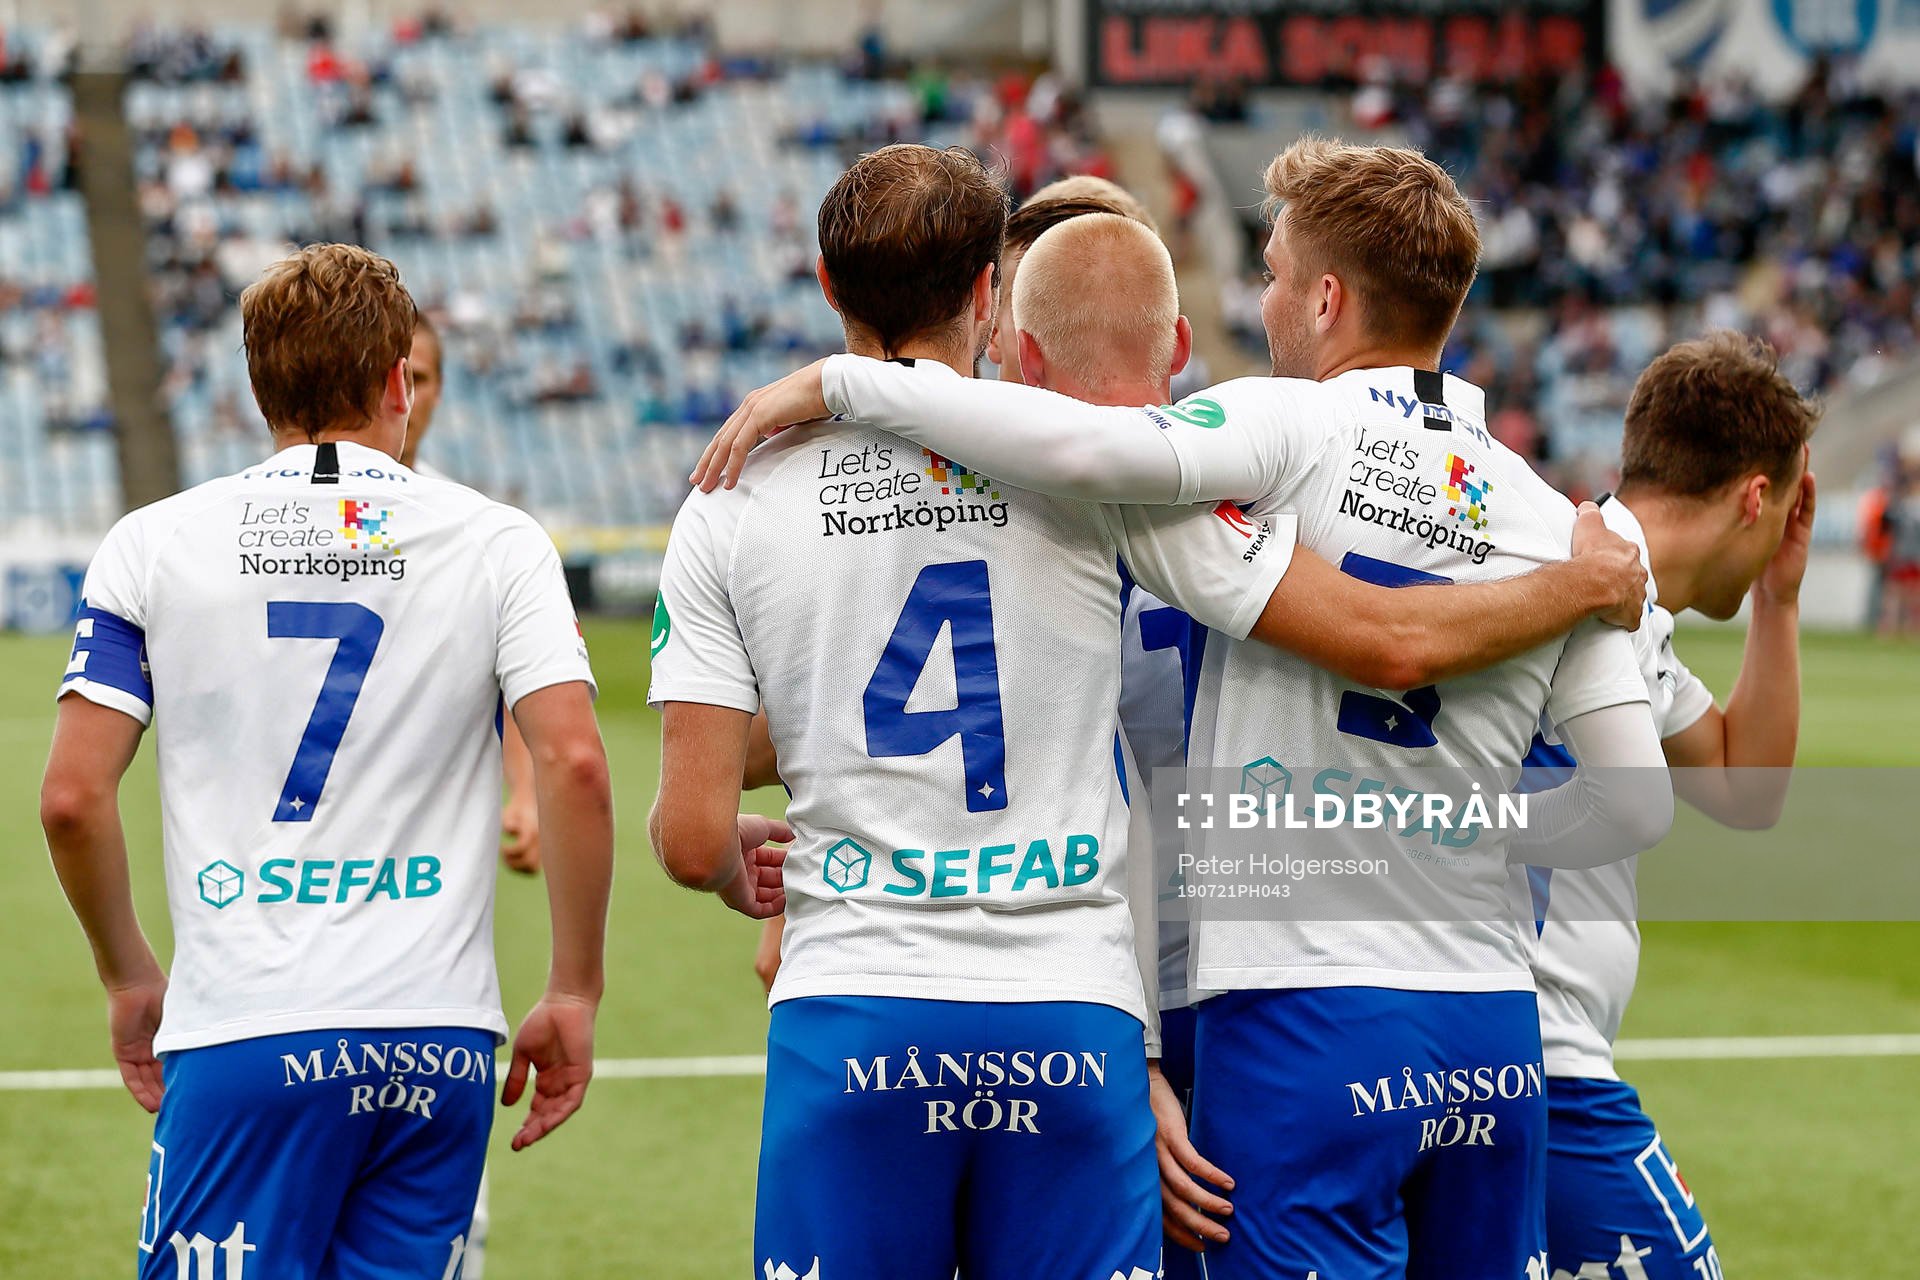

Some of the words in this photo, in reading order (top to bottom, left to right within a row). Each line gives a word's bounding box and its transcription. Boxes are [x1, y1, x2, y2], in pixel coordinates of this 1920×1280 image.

[819, 443, 893, 479] Let's
[1355, 426, 1420, 470] Let's
[818, 469, 921, 507] create
[1349, 460, 1437, 505] create
[238, 525, 334, 548] create
[239, 501, 310, 526] Let's
[821, 499, 1010, 537] Norrköping
[1339, 489, 1495, 565] Norrköping
[239, 553, 407, 582] Norrköping
[863, 559, 1008, 813] 4
[267, 601, 385, 822] 7
[257, 855, 443, 904] SEFAB
[883, 834, 1099, 899] SEFAB
[283, 1038, 490, 1087] MÅNSSON
[843, 1046, 1107, 1094] MÅNSSON
[348, 1075, 437, 1121] RÖR
[923, 1090, 1042, 1135] RÖR
[1345, 1062, 1542, 1118] MÅNSSON
[1418, 1106, 1497, 1153] RÖR
